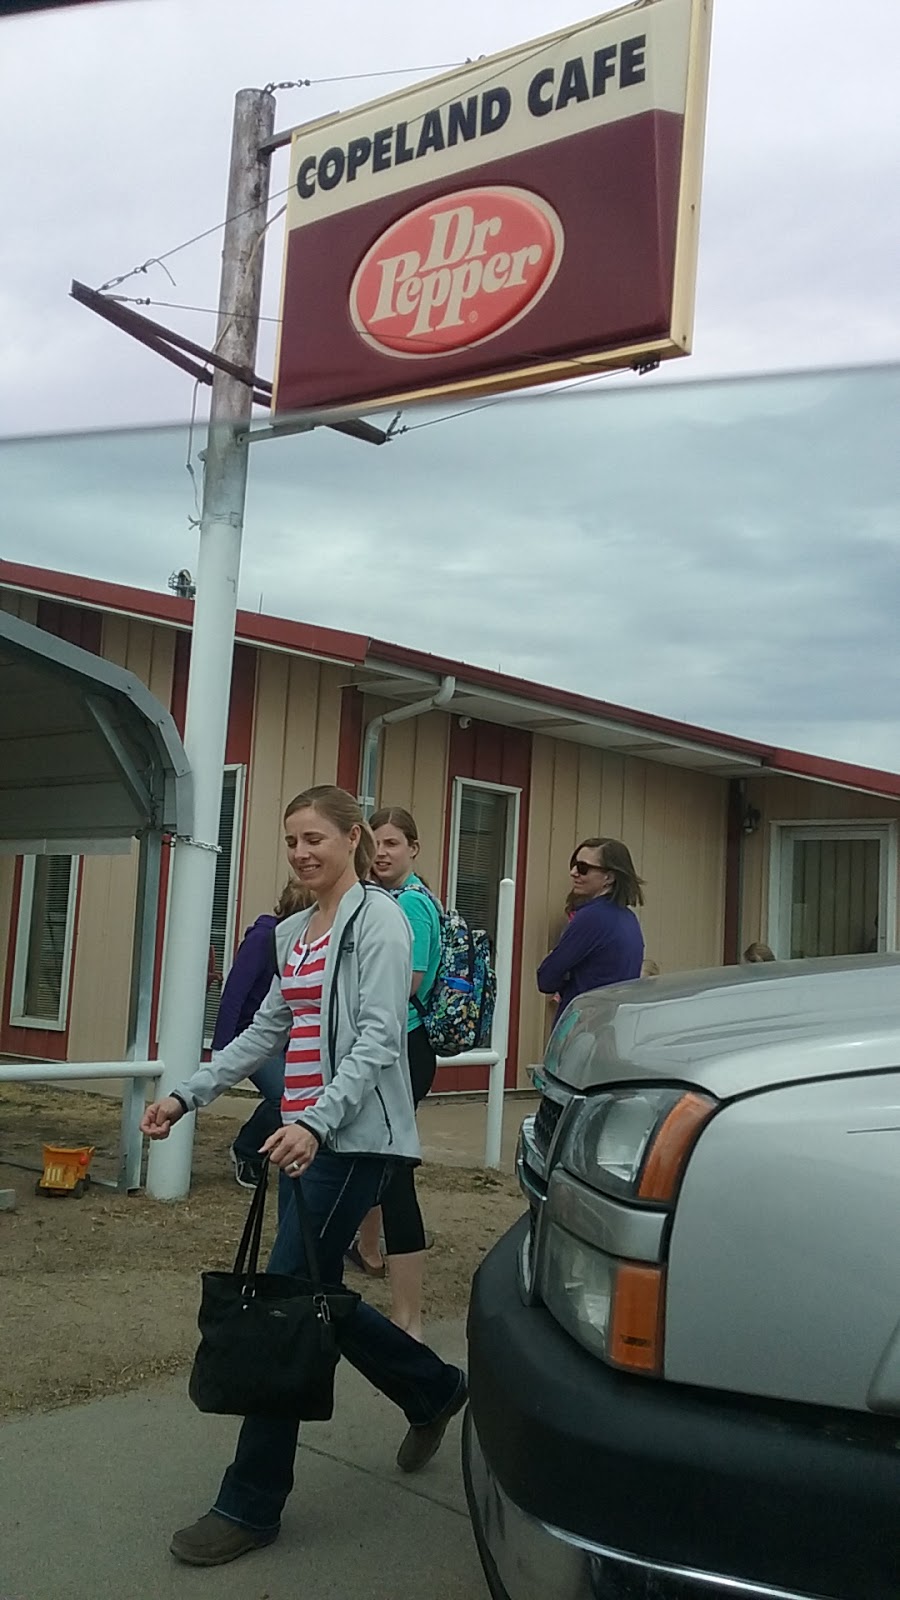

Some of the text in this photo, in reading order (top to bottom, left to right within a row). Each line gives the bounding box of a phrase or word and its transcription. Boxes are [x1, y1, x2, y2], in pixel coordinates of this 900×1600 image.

[296, 34, 647, 199] COPELAND CAFE
[419, 205, 502, 273] Dr
[367, 243, 543, 338] Pepper
